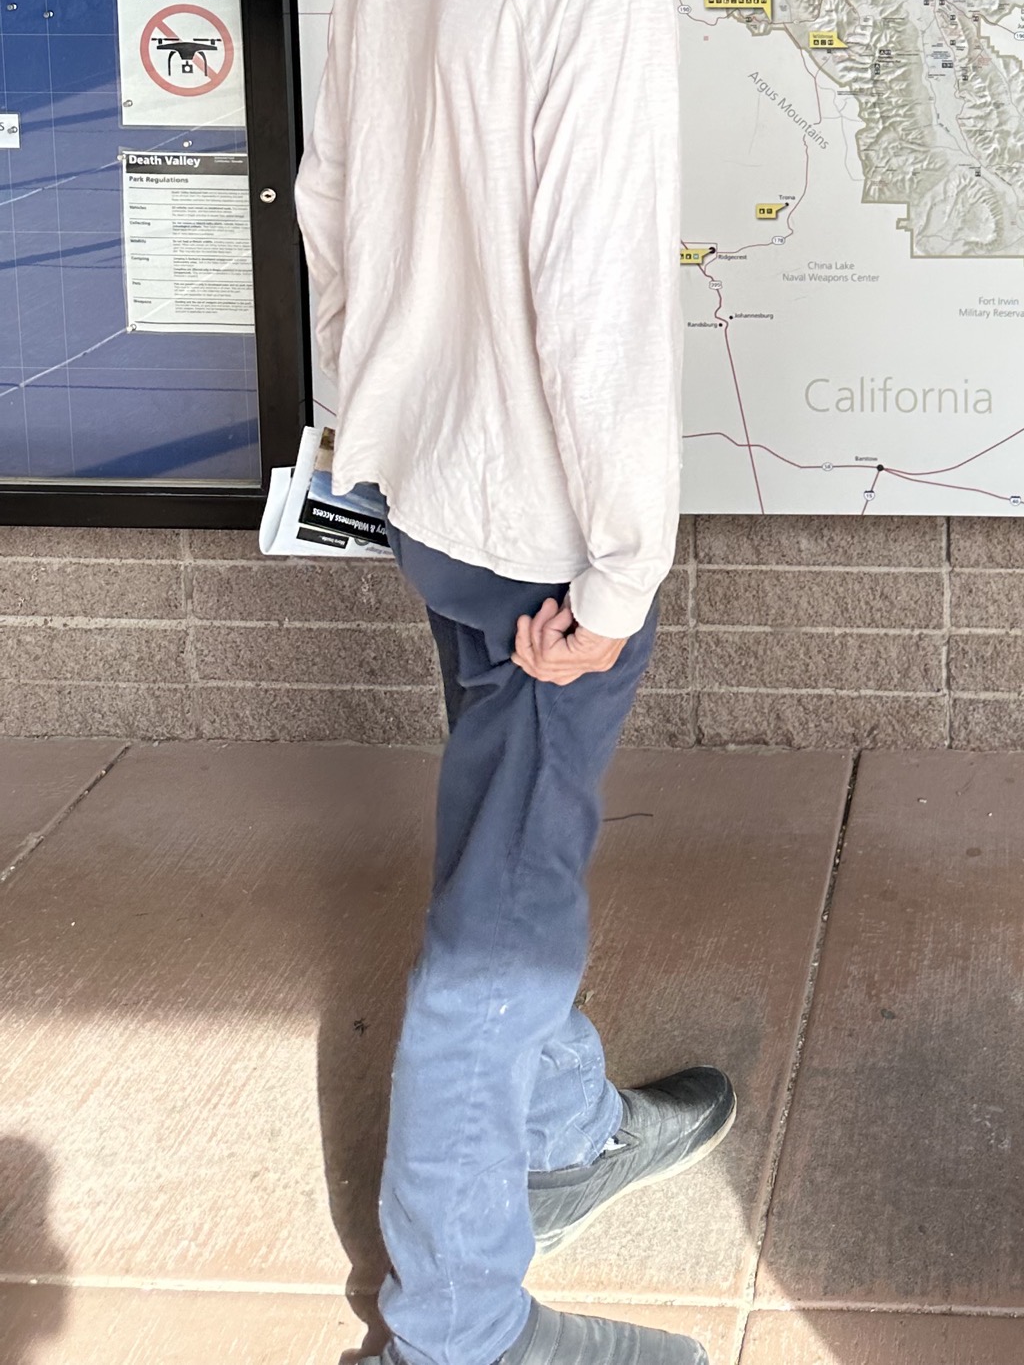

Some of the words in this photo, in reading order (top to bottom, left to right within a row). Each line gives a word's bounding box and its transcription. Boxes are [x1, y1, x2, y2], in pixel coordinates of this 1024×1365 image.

[747, 71, 780, 102] Argus
[776, 96, 831, 151] Mountains
[129, 155, 162, 165] Death
[165, 156, 200, 167] Valley
[718, 253, 747, 261] Ridgecrest
[808, 261, 832, 270] China
[835, 262, 854, 270] Lake
[783, 273, 806, 281] Naval
[808, 273, 848, 283] Weapons
[851, 273, 879, 282] Center
[979, 297, 995, 305] Fort
[959, 308, 990, 318] Military
[804, 375, 993, 415] California
[312, 507, 335, 522] Access
